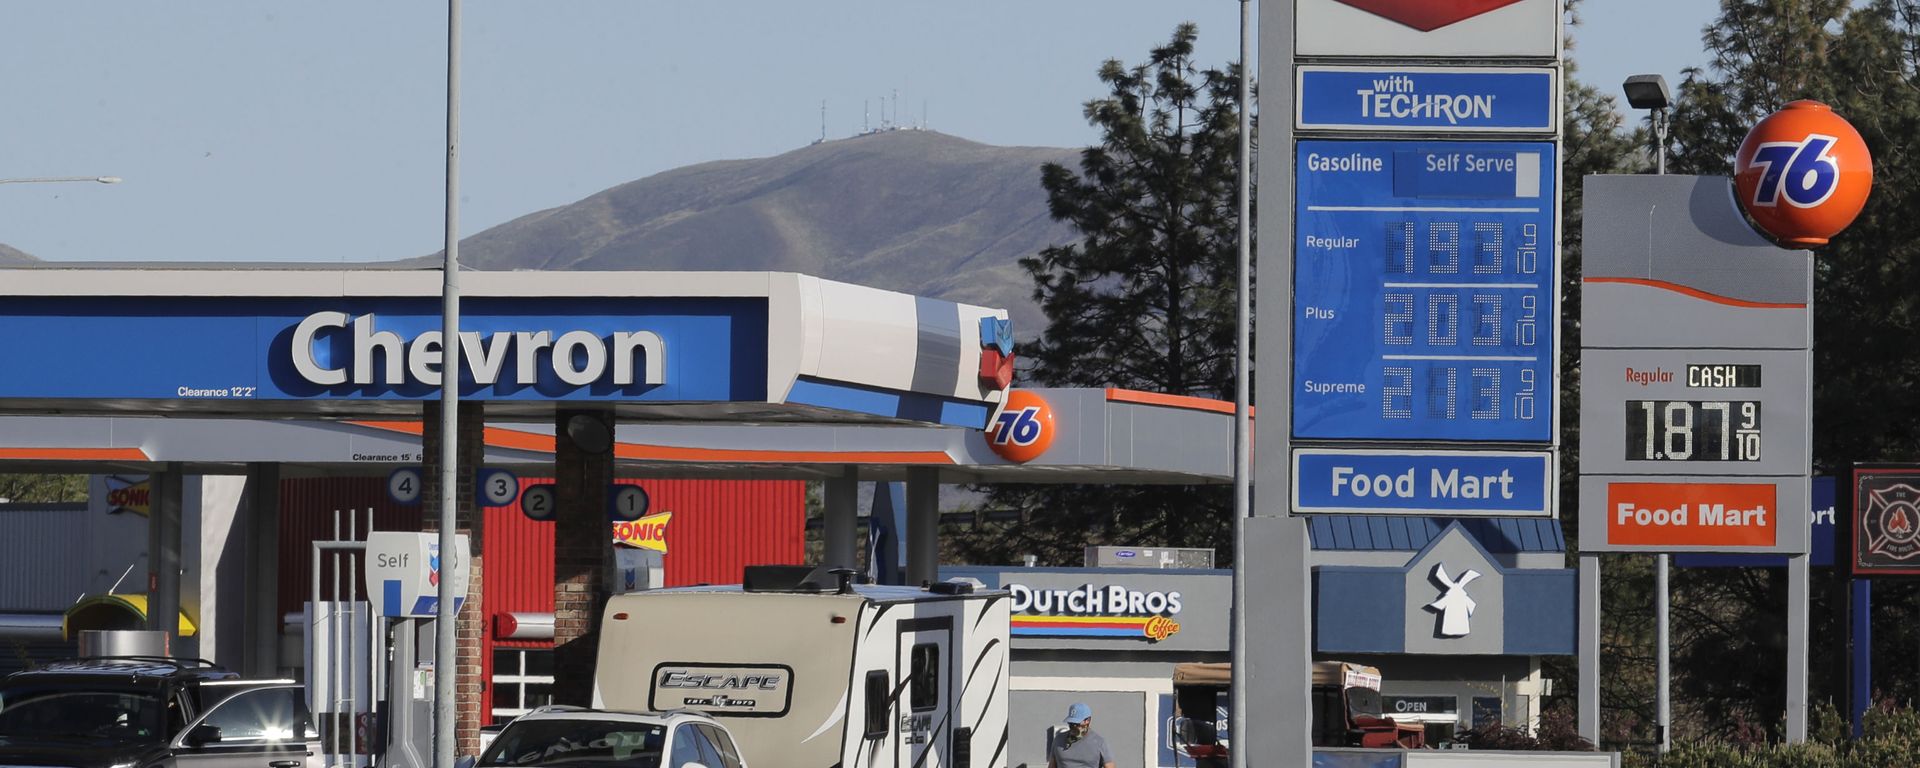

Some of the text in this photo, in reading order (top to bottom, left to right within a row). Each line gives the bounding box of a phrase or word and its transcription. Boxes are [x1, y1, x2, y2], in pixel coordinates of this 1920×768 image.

[1373, 76, 1414, 93] with
[1357, 89, 1493, 124] TECHRON
[1308, 153, 1383, 172] Gasoline
[1426, 154, 1514, 172] Self Serve
[1749, 134, 1841, 209] 76
[1306, 235, 1360, 250] Regular
[1405, 222, 1502, 274] 193
[1305, 307, 1335, 320] Plus
[1384, 294, 1502, 346] 203
[292, 311, 667, 386] Chevron
[1626, 366, 1737, 388] Regular CASH
[178, 386, 229, 397] Clearance
[1304, 380, 1366, 395] Supreme
[1383, 367, 1501, 420] 213
[994, 406, 1041, 446] 76
[1641, 401, 1730, 461] 1.87
[352, 453, 398, 462] Clearance
[398, 477, 413, 494] 4
[494, 479, 508, 497] 3
[1332, 466, 1514, 500] Food Mart
[532, 494, 546, 511] 2
[627, 495, 636, 511] 1
[1617, 503, 1767, 527] Food Mart
[613, 522, 666, 542] SONIC
[377, 553, 409, 568] Self
[1010, 583, 1182, 614] DUTCH BROS
[1144, 616, 1180, 639] Coffee
[659, 668, 781, 690] ESCAPE
[1396, 700, 1427, 713] OPEN
[1216, 719, 1229, 731] OS
